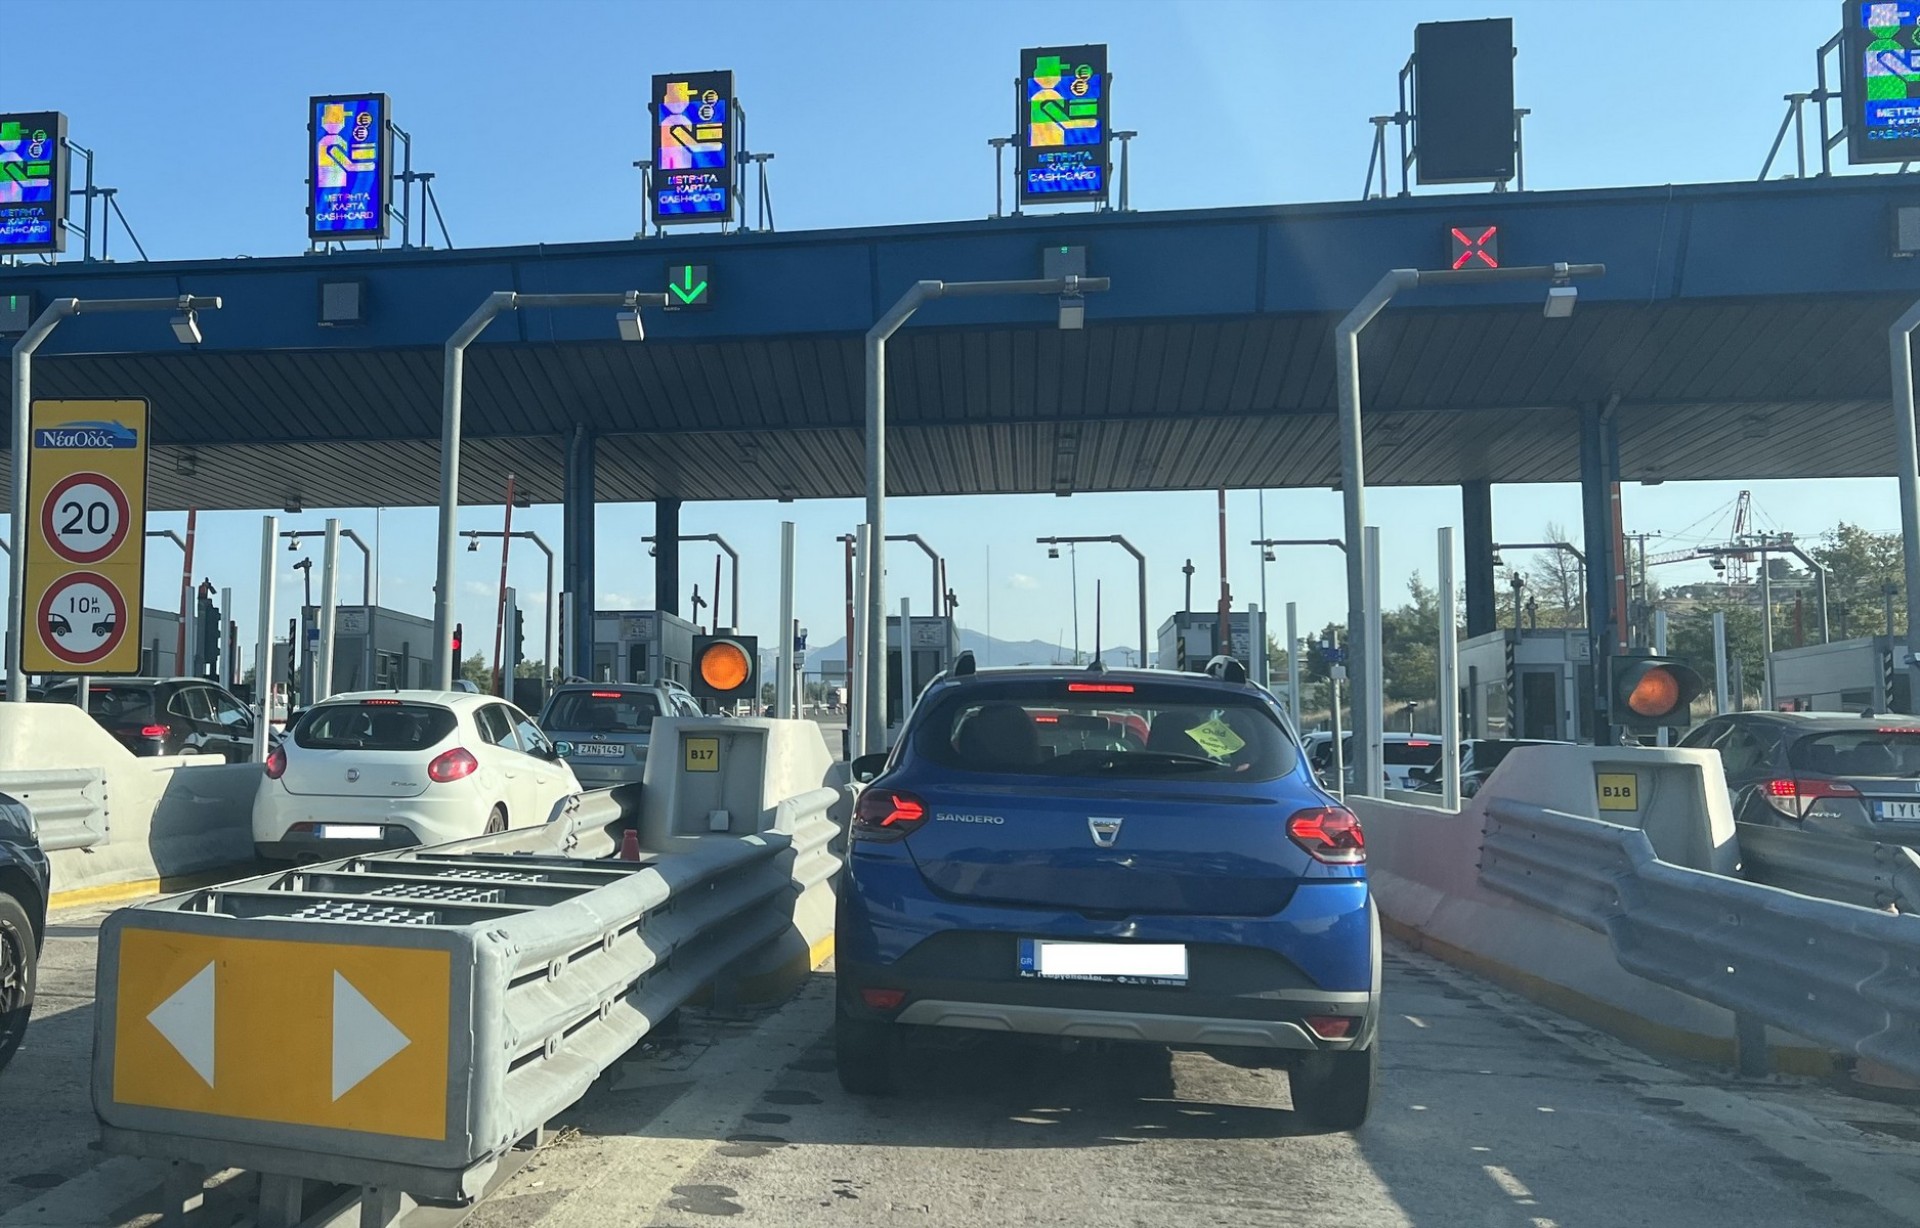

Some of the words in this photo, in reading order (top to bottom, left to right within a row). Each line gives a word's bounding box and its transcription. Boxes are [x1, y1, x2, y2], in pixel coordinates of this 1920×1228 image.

[61, 501, 110, 535] 20
[70, 597, 90, 614] 10
[691, 749, 715, 760] B17
[1603, 786, 1632, 798] B18
[936, 812, 1005, 825] SANDERO
[1020, 957, 1033, 966] GR
